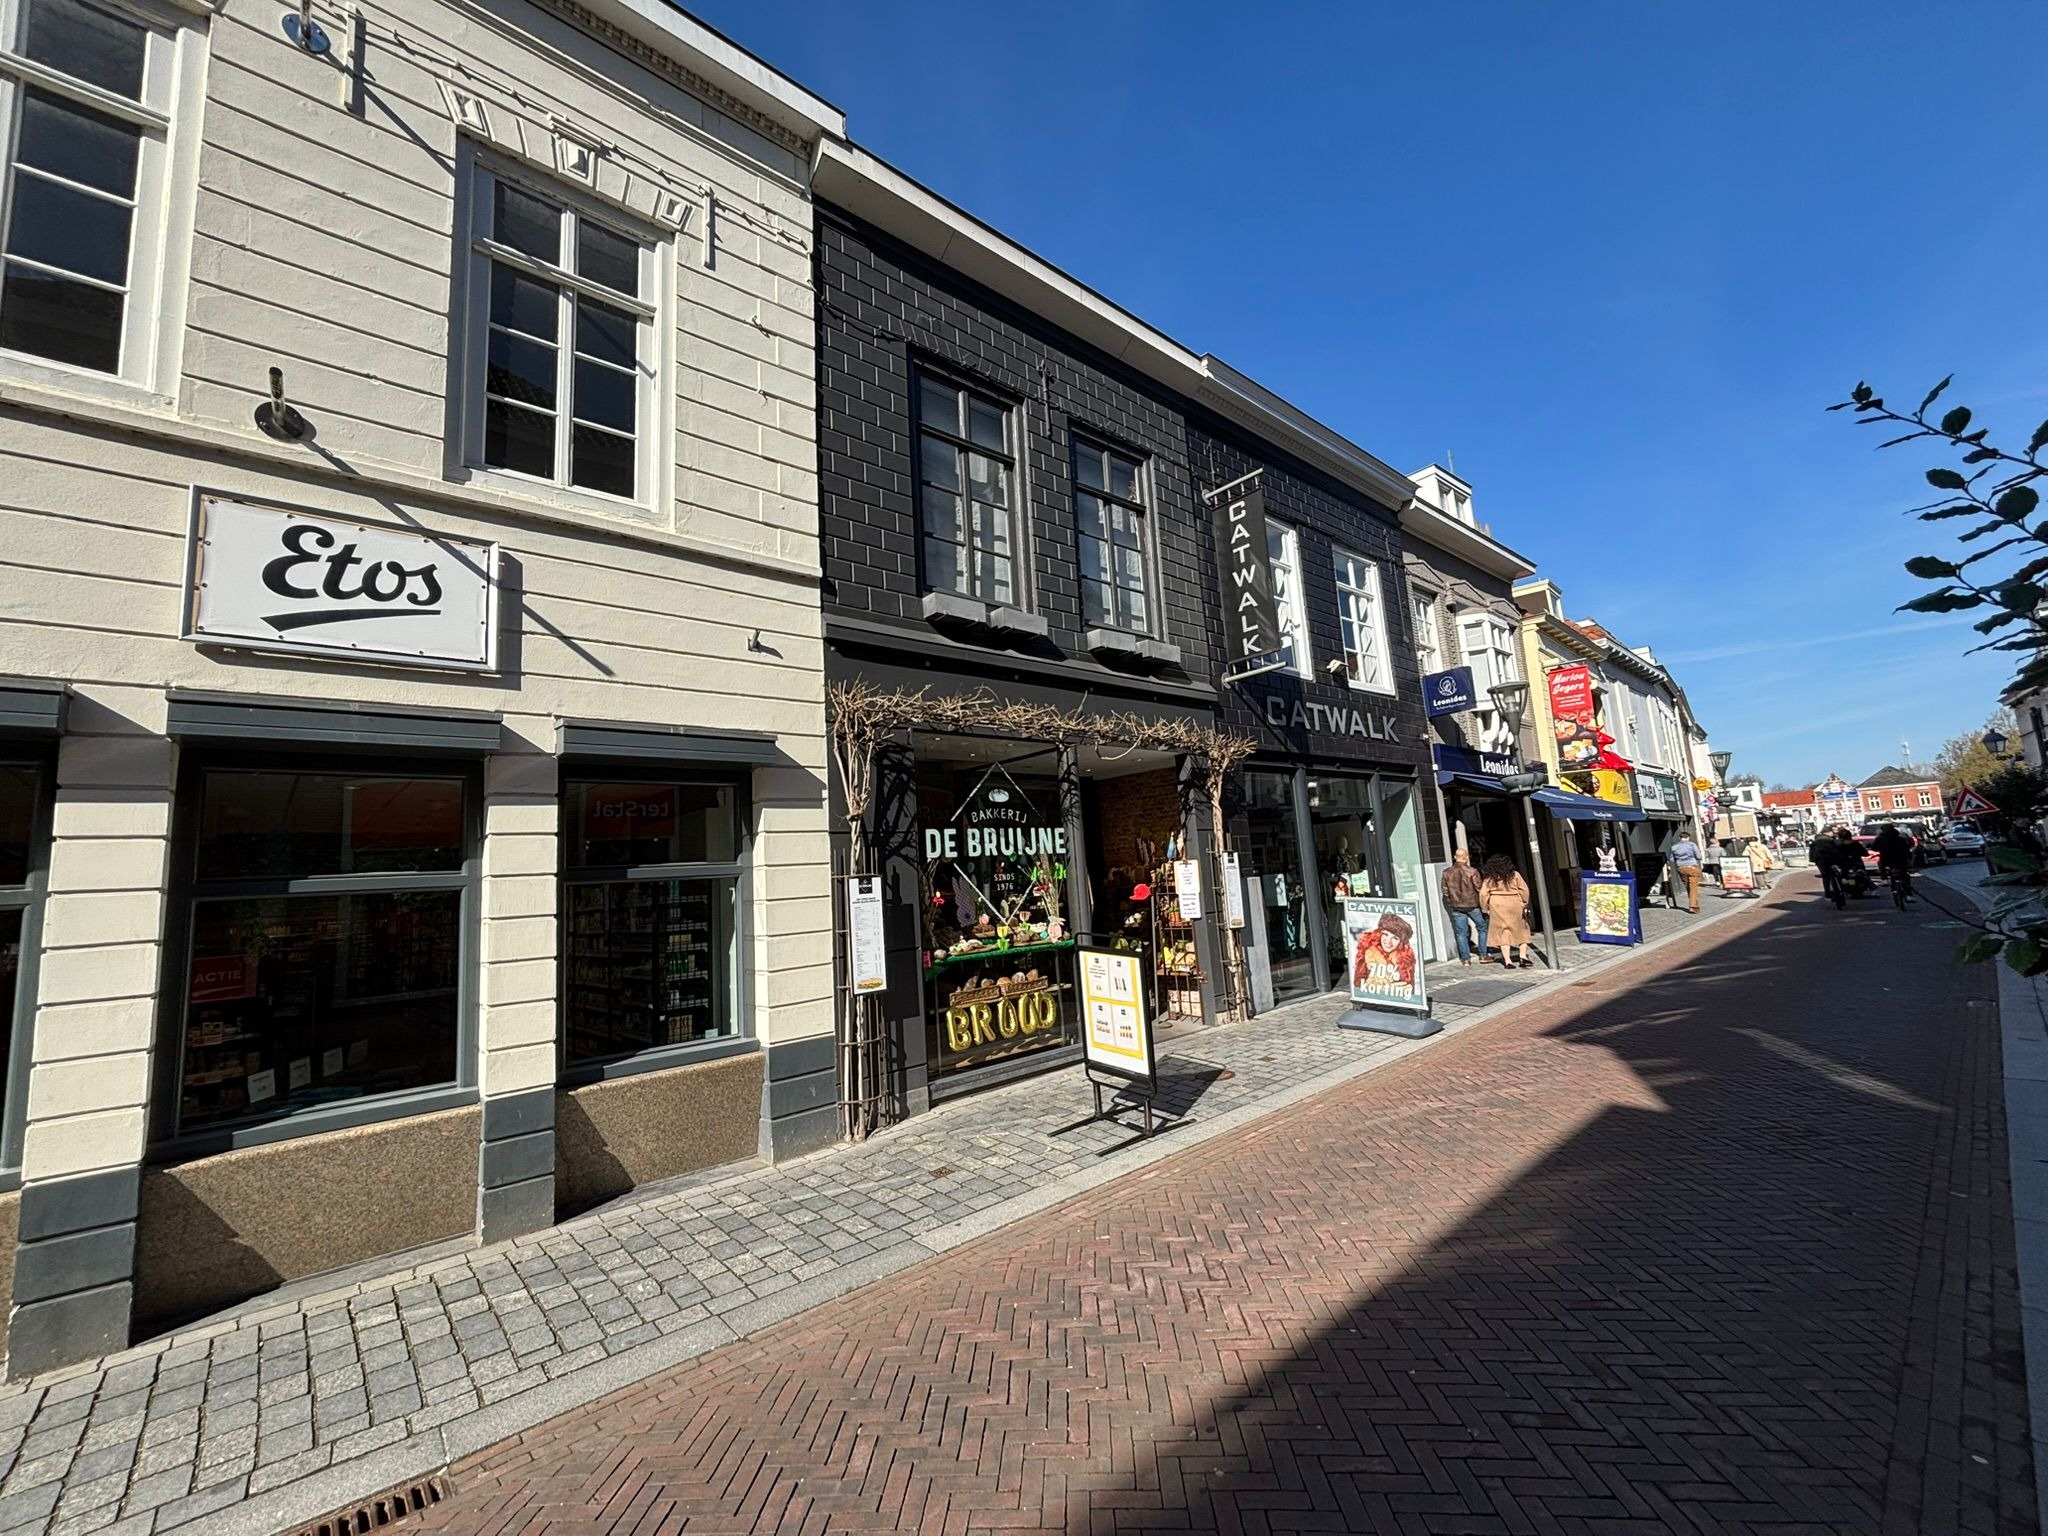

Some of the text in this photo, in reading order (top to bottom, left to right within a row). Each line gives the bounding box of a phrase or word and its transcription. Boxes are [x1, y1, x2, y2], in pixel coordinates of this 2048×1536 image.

[262, 524, 443, 606] Etos
[1229, 501, 1262, 655] CATWALK
[1433, 695, 1467, 707] Leonidas
[1266, 695, 1400, 742] CATWALK
[1479, 755, 1519, 776] Leonidas
[970, 808, 1027, 823] BAKKERIJ
[925, 827, 1067, 859] DE BRUIJNE
[993, 873, 1015, 881] SINDS
[996, 883, 1014, 891] 1976
[1348, 902, 1414, 915] CATWALK
[194, 969, 243, 984] ACTIE
[1369, 963, 1399, 981] 70%
[946, 991, 1057, 1052] BROOD
